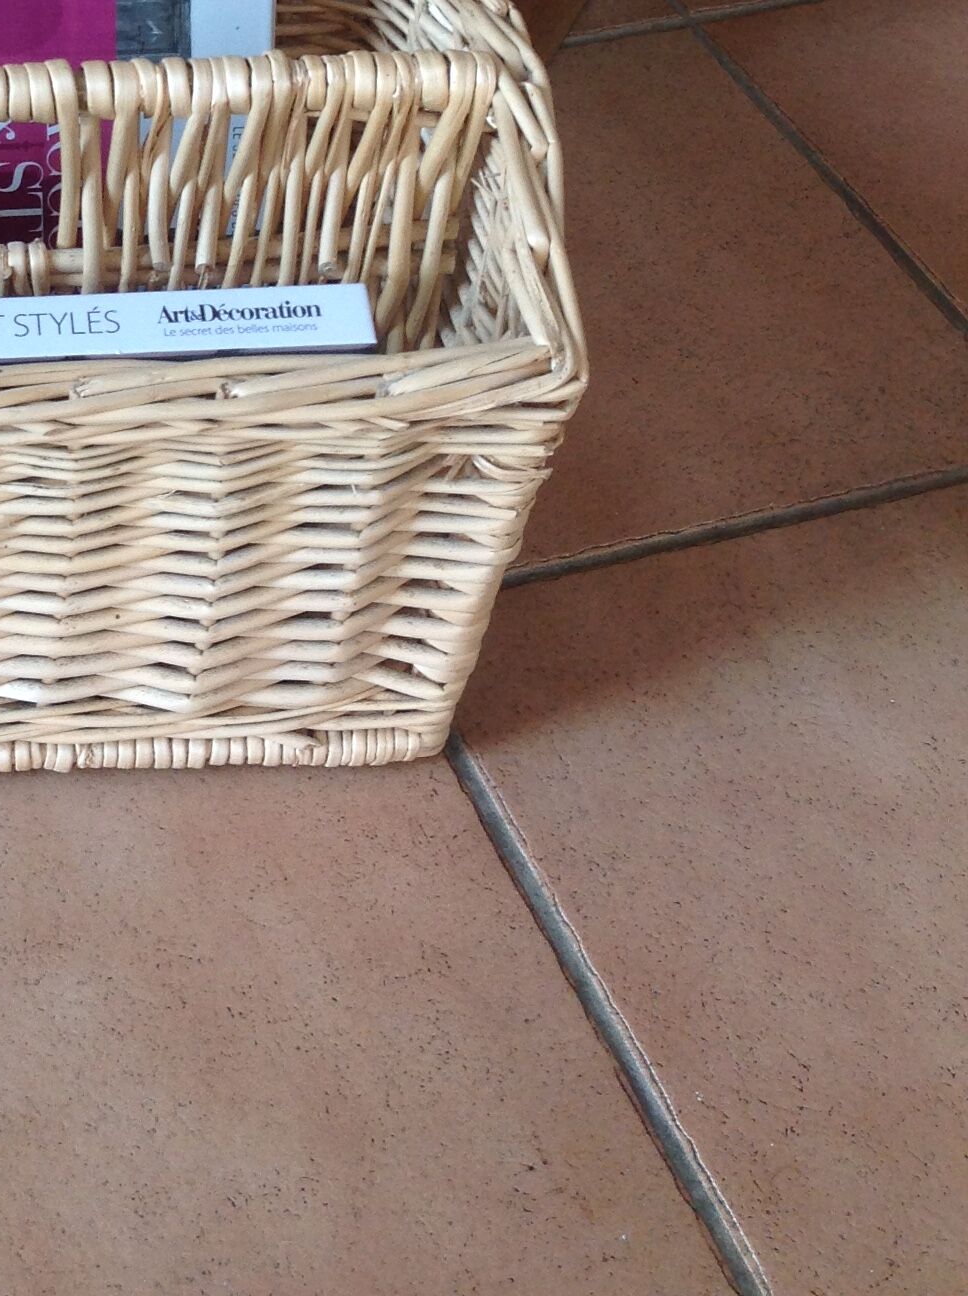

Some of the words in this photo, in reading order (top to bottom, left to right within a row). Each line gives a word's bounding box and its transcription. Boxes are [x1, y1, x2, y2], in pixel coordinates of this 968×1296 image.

[12, 305, 121, 338] STYLÉS
[156, 299, 323, 325] Art&Décoration
[163, 326, 177, 338] Le
[178, 324, 213, 337] secret
[214, 322, 234, 335] des
[236, 321, 270, 335] belles
[272, 319, 318, 333] maisons
